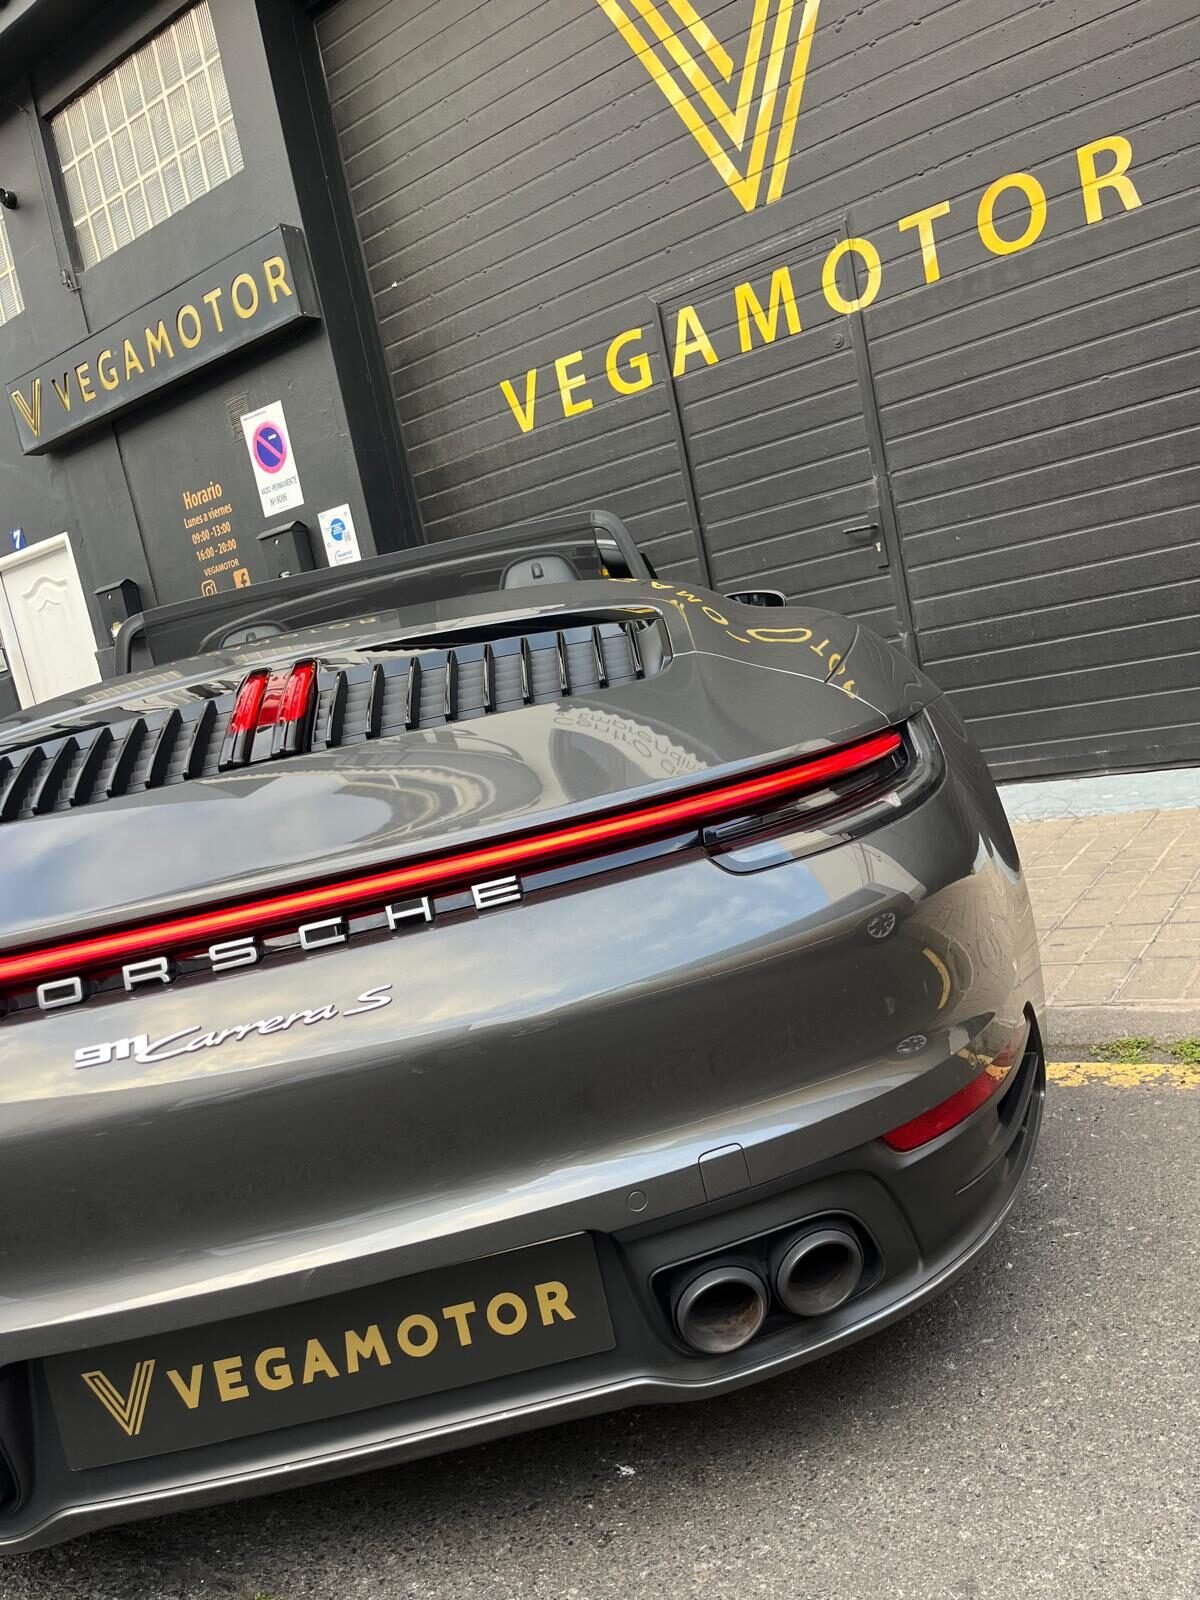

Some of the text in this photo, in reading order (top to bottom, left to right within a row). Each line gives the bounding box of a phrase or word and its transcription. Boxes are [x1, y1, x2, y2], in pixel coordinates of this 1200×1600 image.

[500, 135, 1144, 433] VEGAMOTOR
[51, 256, 293, 413] VEGAMOTOR
[183, 481, 223, 510] Horario
[183, 503, 233, 529] Lunes a viernes
[13, 529, 21, 550] 7
[203, 558, 240, 577] VEGAMOTOR
[135, 1001, 339, 1064] Carrera
[343, 983, 392, 1016] S
[166, 1281, 576, 1409] VEGAMOTOR
